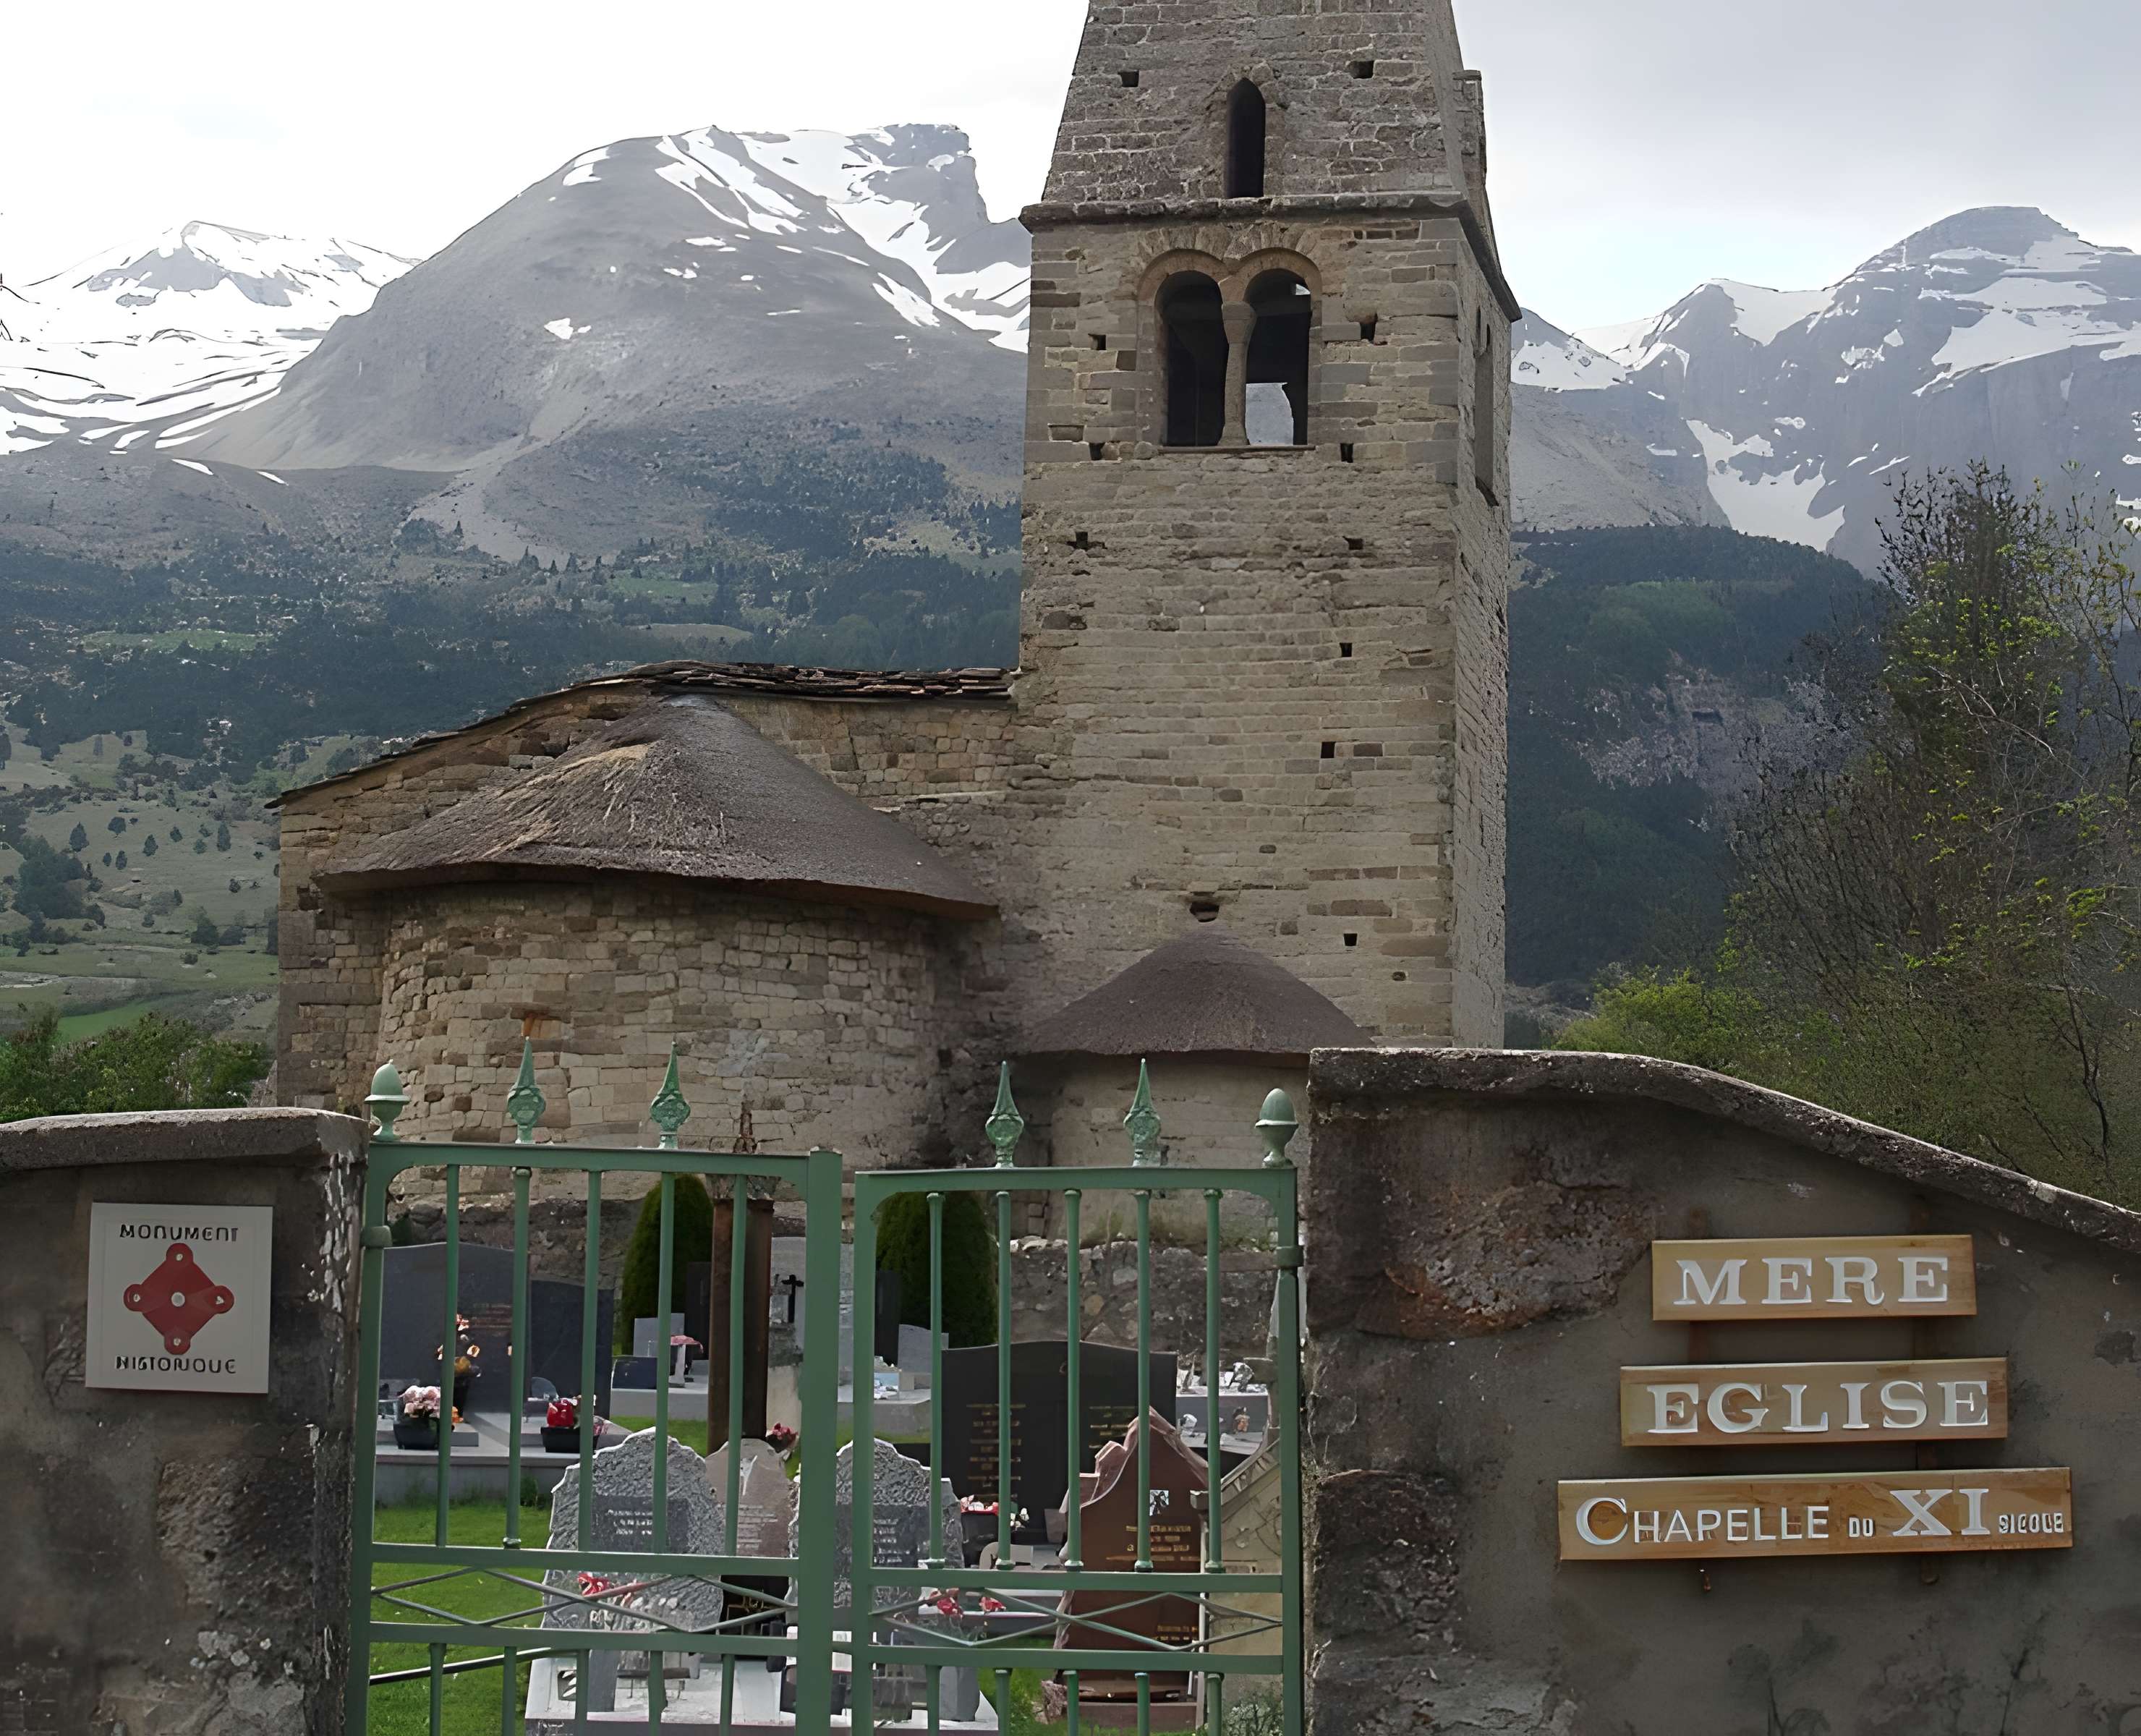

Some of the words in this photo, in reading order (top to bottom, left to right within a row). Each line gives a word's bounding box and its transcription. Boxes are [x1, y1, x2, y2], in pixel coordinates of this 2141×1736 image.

[119, 1224, 238, 1241] MONUMENT
[1673, 1256, 1949, 1306] MERE
[1647, 1379, 1989, 1433] EGLISE
[1575, 1497, 1831, 1546] CHAPELLE
[1889, 1489, 1991, 1536] XI
